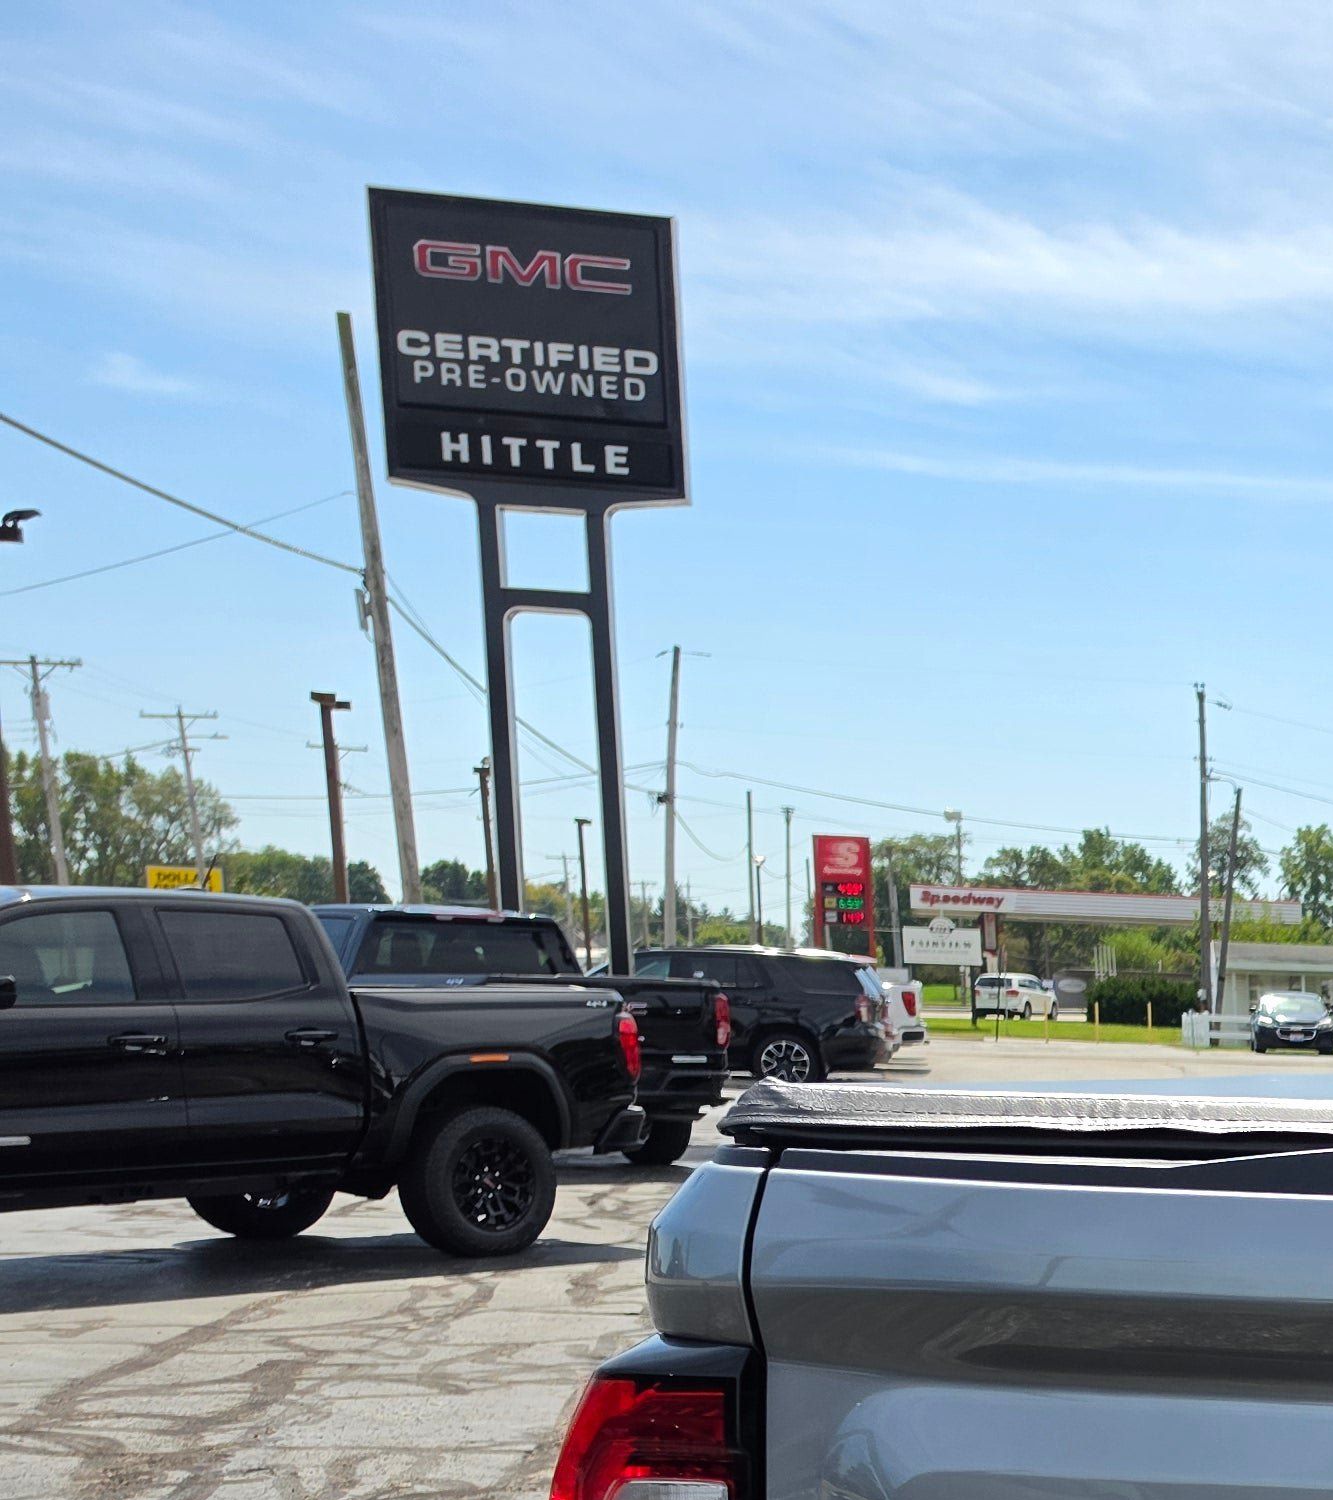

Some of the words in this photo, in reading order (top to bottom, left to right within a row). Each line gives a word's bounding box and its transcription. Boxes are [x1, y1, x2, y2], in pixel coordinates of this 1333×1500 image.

[413, 239, 632, 295] GMC
[397, 329, 659, 376] CERTIFIED
[413, 359, 647, 401] PRE-OWNED
[440, 431, 630, 476] HITTLE
[921, 890, 1004, 909] Speedway
